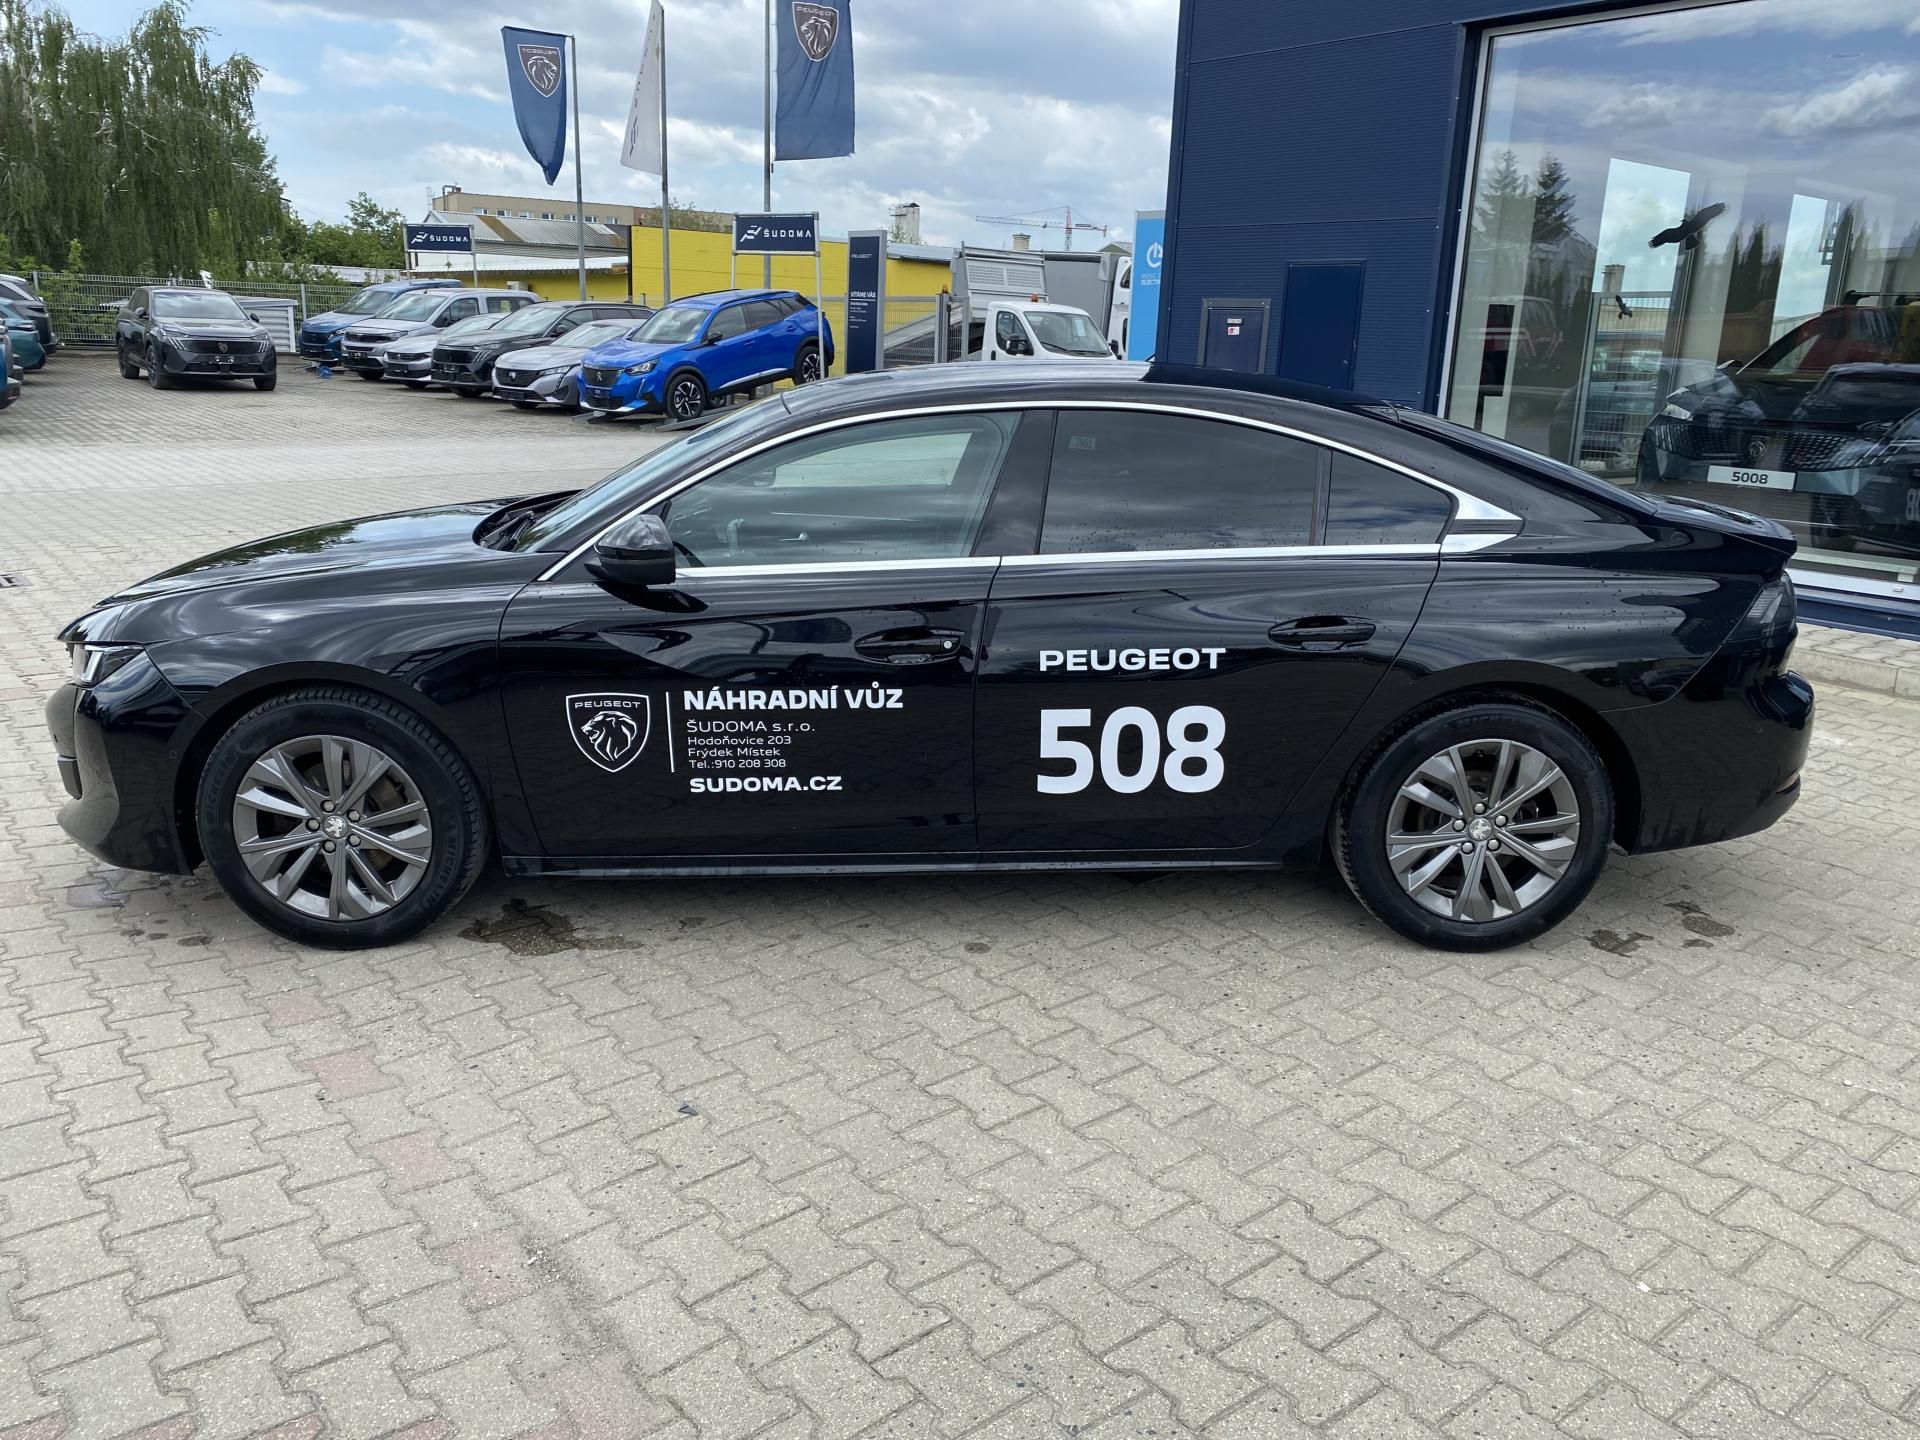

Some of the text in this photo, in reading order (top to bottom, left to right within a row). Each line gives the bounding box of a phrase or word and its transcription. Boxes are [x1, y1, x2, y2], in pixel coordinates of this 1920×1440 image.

[796, 6, 835, 16] PEUGEOT
[1731, 471, 1769, 485] 5008
[1039, 647, 1226, 672] PEUGEOT
[683, 681, 904, 711] NÁHRADNÍ VŮZ
[574, 700, 641, 709] PEUGEOT
[686, 719, 816, 733] ŠUDOMA s.r.o.
[687, 735, 792, 746] Hodoňovice 203
[688, 747, 781, 759] Frýdek Místek
[1036, 705, 1226, 795] 508
[738, 759, 761, 768] 208
[763, 759, 787, 768] 308
[689, 775, 843, 793] SUDOMA.CZ
